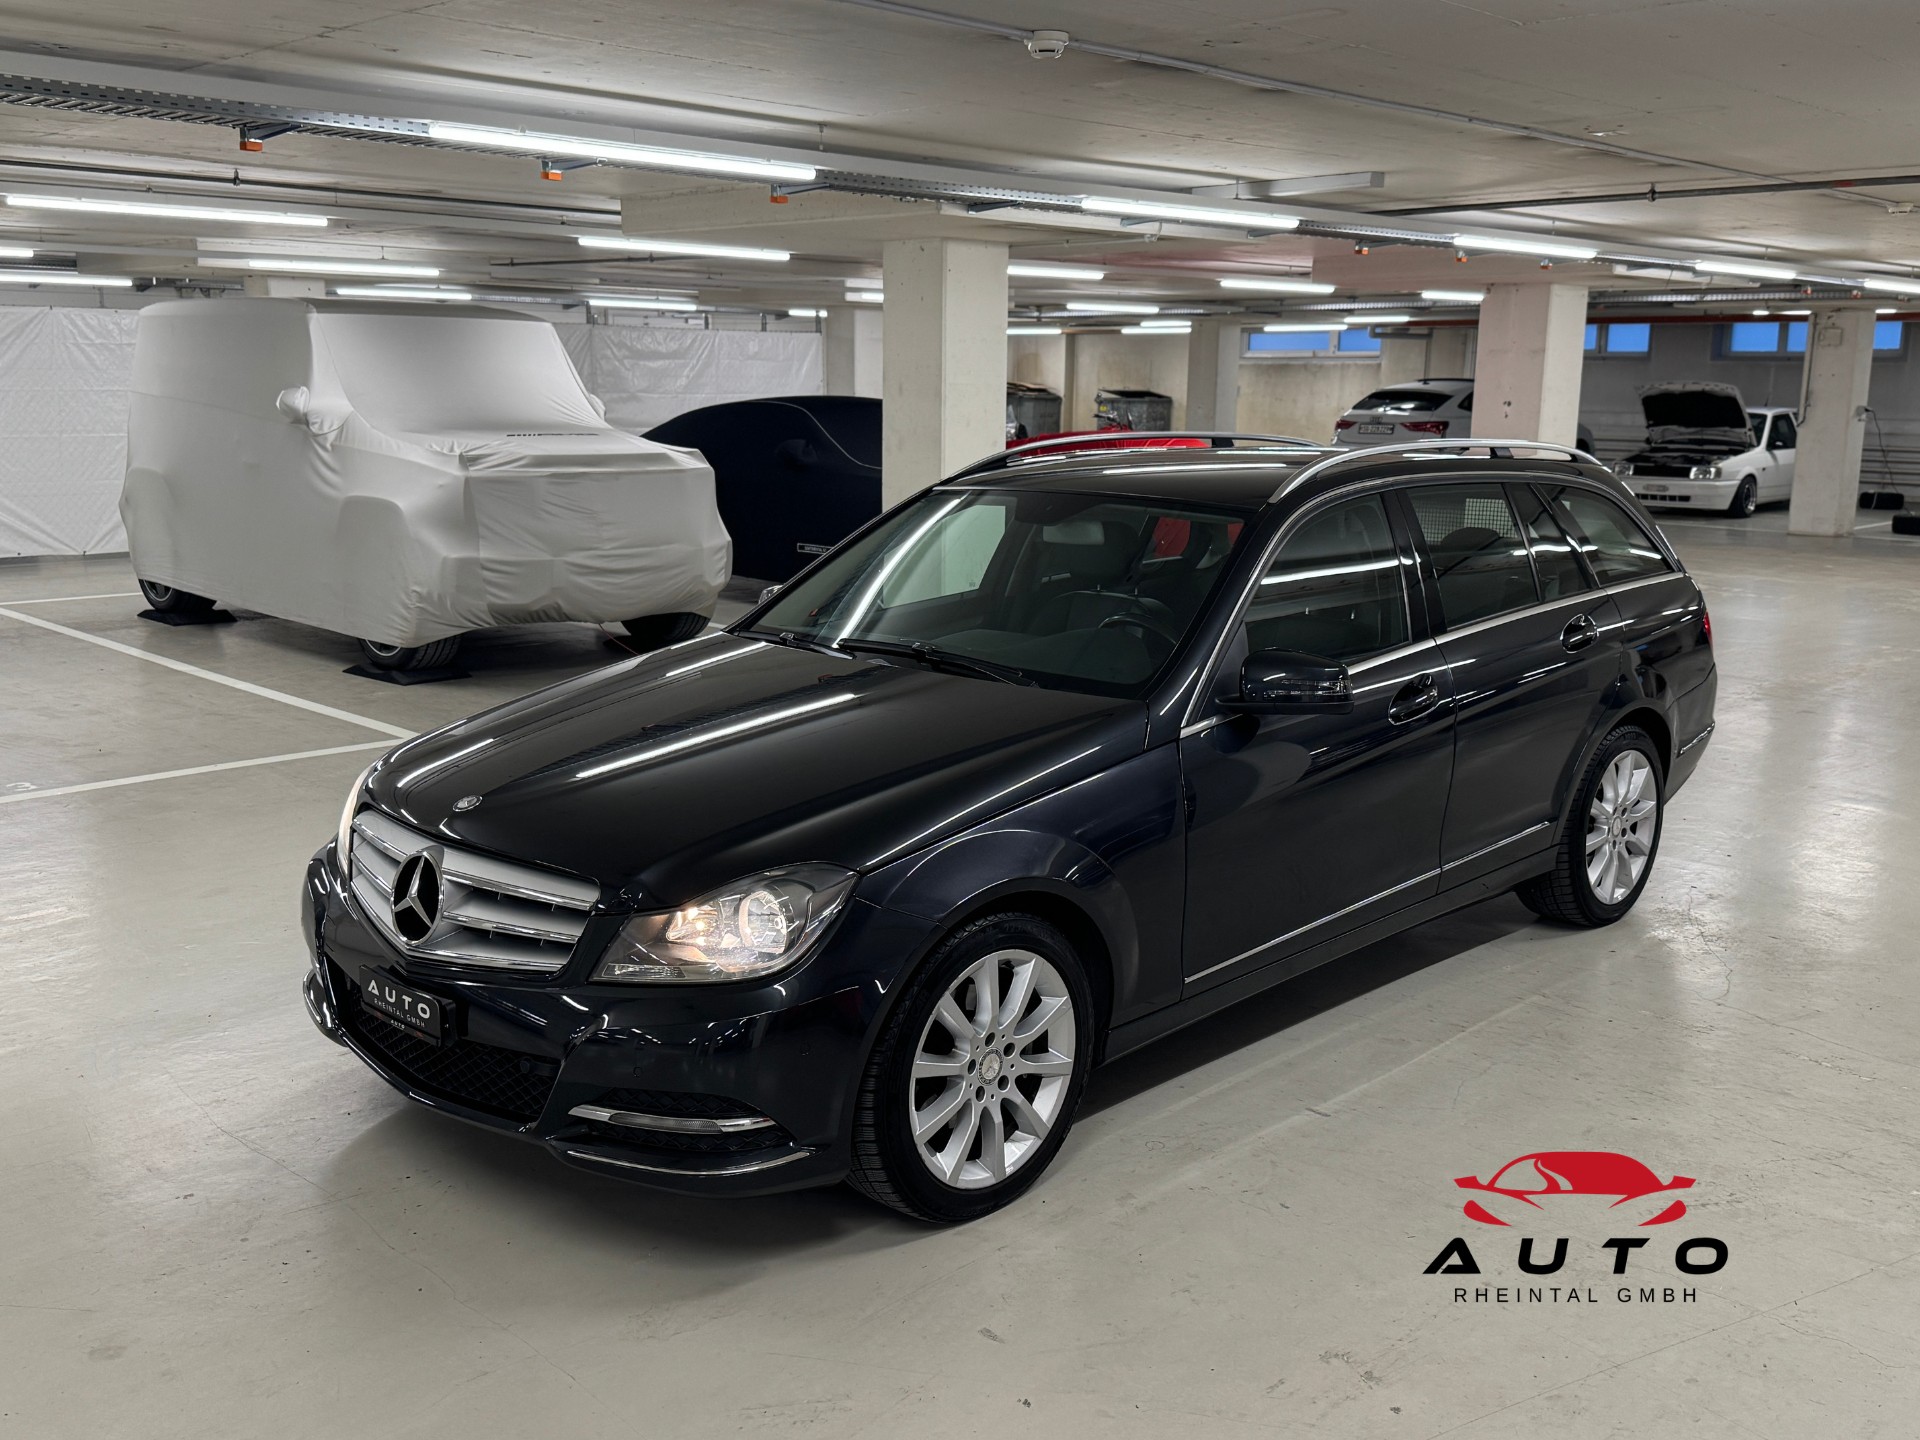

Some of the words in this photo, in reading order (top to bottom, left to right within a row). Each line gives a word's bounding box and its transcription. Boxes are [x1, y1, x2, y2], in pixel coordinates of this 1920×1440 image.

[367, 979, 431, 1019] AUTO
[374, 998, 404, 1018] RHEINTAL
[406, 1014, 425, 1028] GMBH
